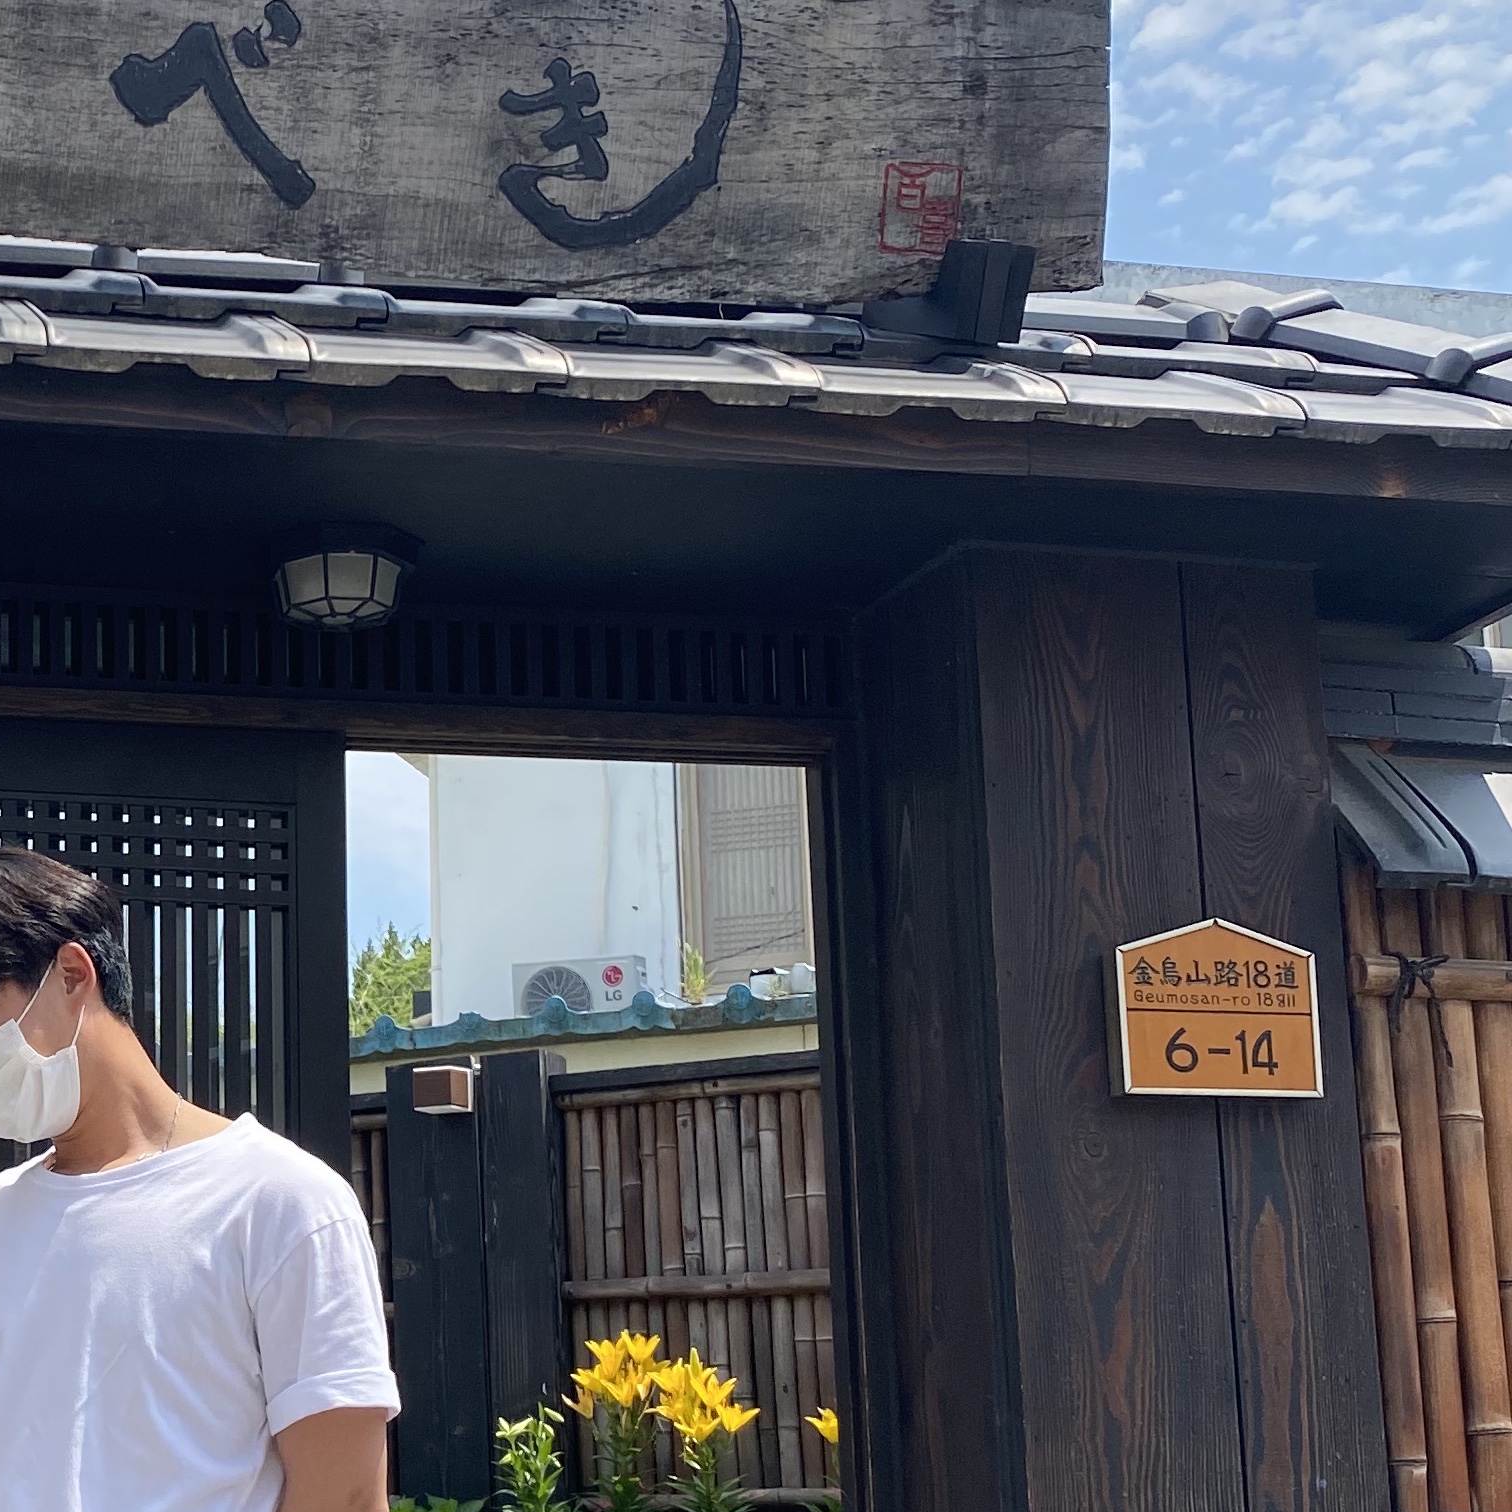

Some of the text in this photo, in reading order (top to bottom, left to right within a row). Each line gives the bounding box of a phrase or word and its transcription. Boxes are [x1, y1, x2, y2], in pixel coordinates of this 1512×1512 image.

[605, 990, 622, 1002] LG
[1134, 989, 1251, 1007] Geumosan-ro
[1165, 1027, 1279, 1076] 6-14
